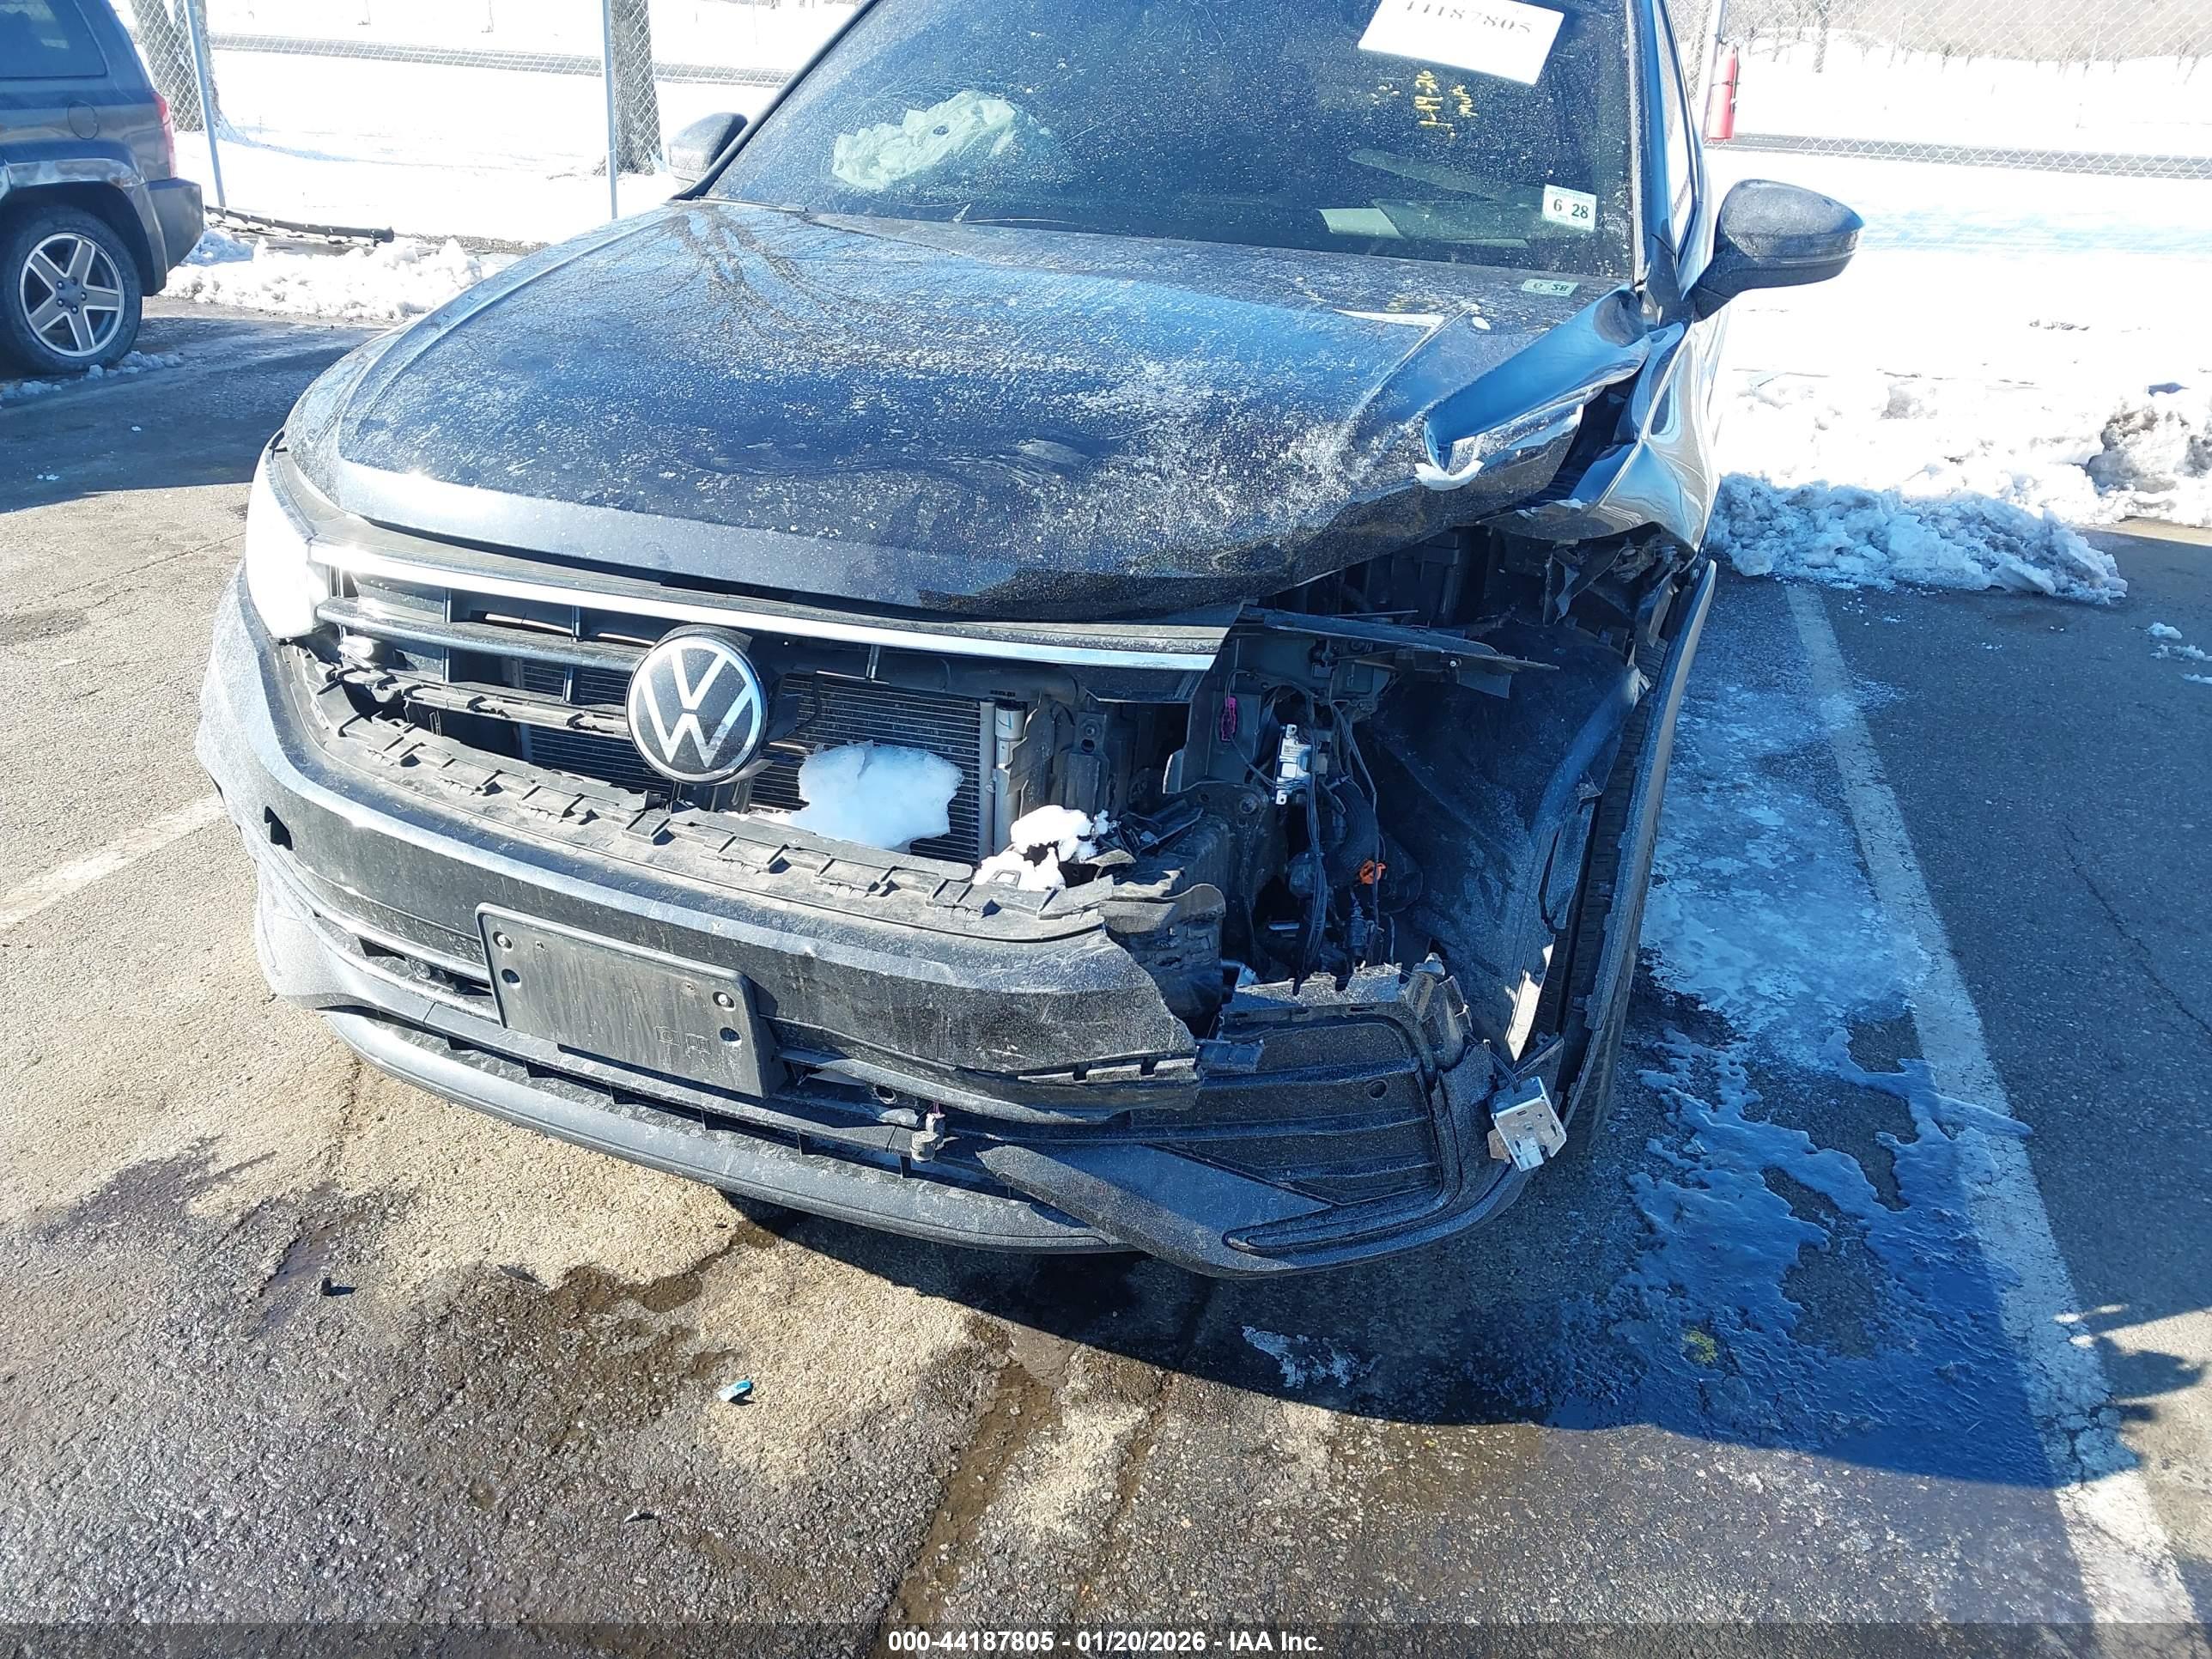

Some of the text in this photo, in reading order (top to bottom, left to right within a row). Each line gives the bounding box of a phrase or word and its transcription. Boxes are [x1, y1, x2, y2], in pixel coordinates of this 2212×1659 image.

[1553, 198, 1589, 219] 6 28
[635, 644, 756, 771] VW
